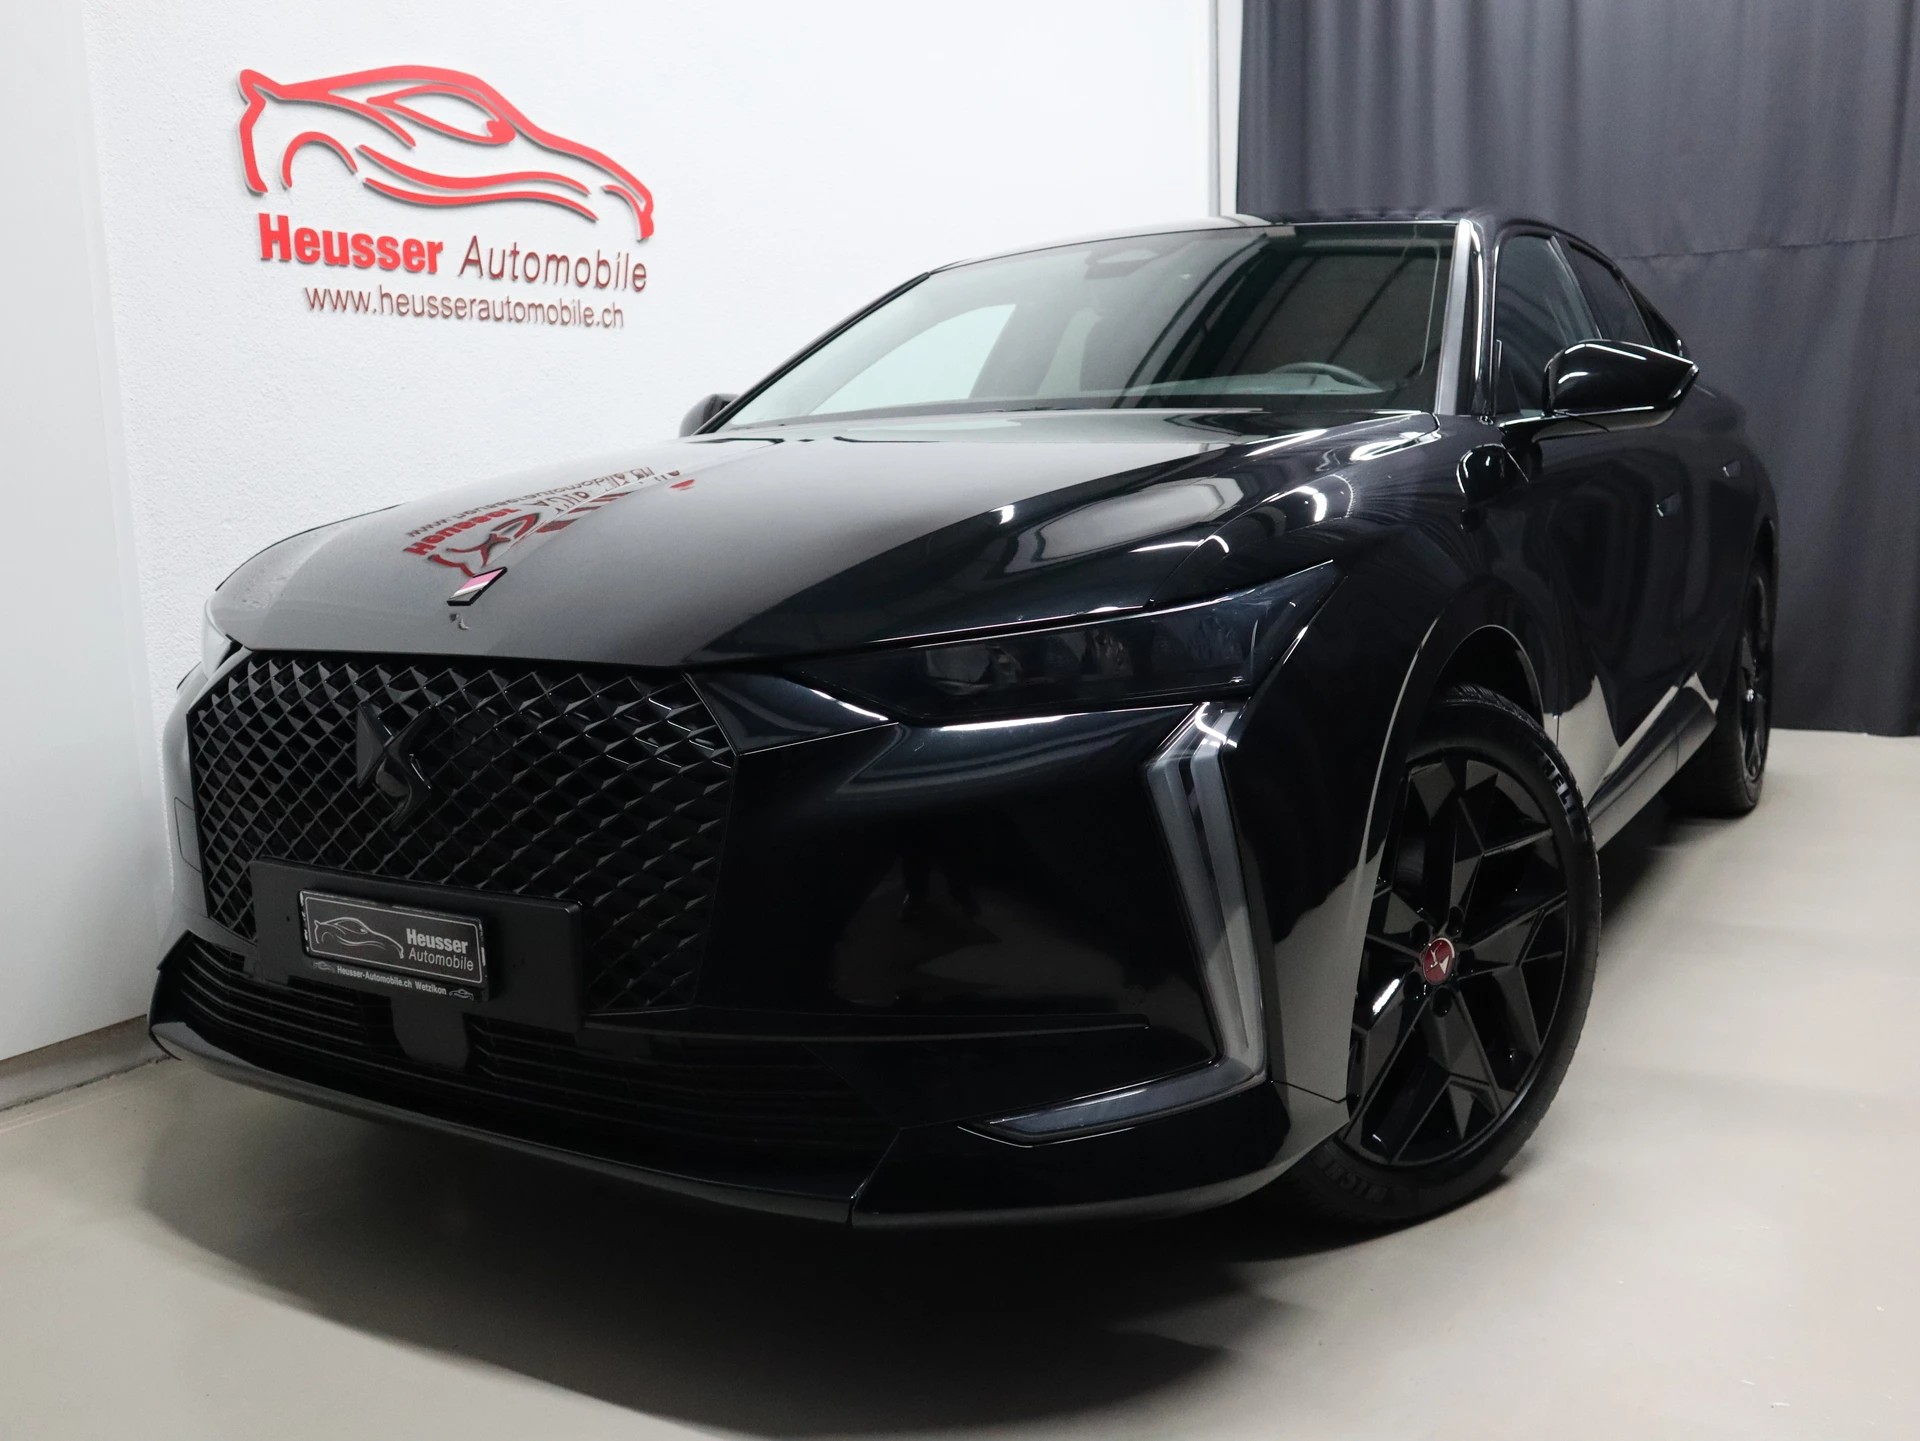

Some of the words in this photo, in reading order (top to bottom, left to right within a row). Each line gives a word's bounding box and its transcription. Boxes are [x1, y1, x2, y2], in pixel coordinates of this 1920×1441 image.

[258, 212, 443, 273] Heusser
[459, 235, 647, 292] Automobile
[304, 285, 625, 328] www.heusserautomobile.ch
[406, 928, 468, 954] Heusser
[408, 948, 474, 972] Automobile
[336, 964, 413, 989] Heusser-Automobile.ch
[415, 980, 447, 996] Wetzikon
